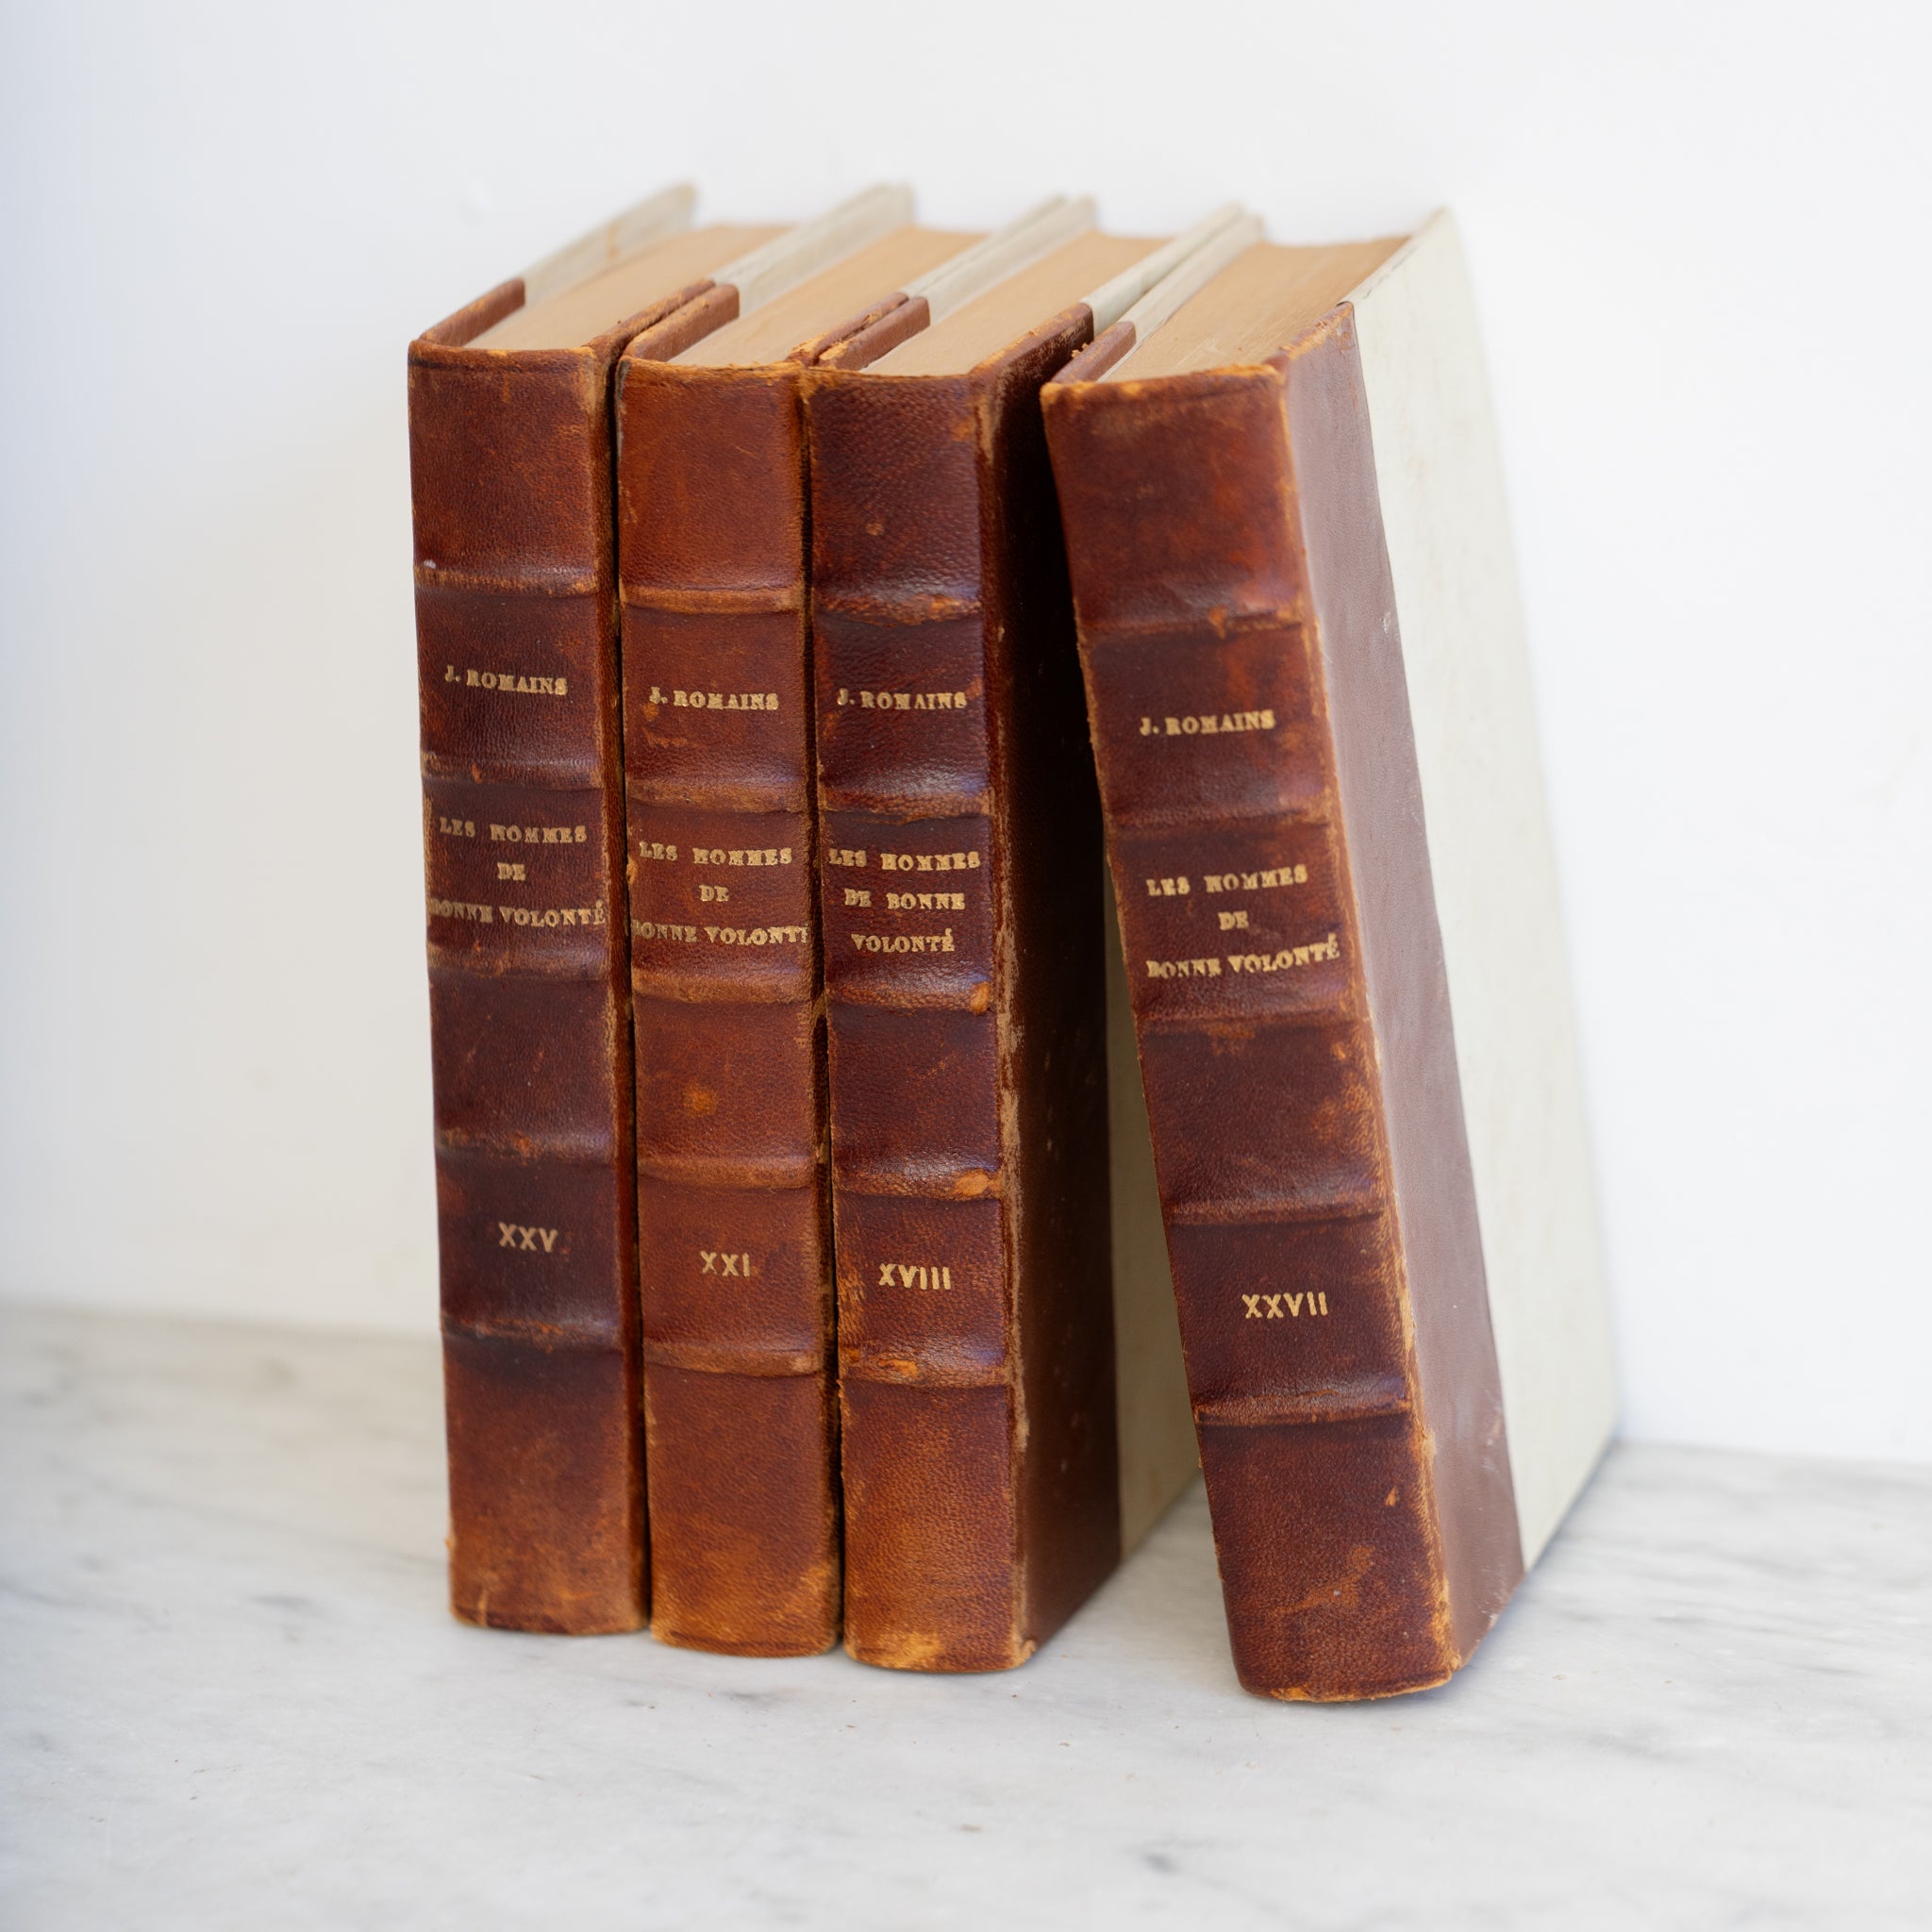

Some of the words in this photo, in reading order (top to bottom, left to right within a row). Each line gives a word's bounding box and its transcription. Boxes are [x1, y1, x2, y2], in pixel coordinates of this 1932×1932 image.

[444, 665, 461, 682] J.
[466, 669, 569, 696] ROMAINS
[649, 687, 668, 704] J.
[673, 690, 779, 710] ROMAINS
[837, 689, 856, 706] J.
[860, 691, 968, 709] ROMAINS
[1140, 717, 1159, 736] J.
[1164, 709, 1275, 736] ROMAINS
[440, 817, 476, 838] LES
[490, 824, 588, 843] HOMMES
[639, 841, 678, 861] LES
[692, 847, 792, 866] HOMMES
[828, 849, 867, 867] LES
[880, 851, 981, 871] HOMMES
[497, 862, 526, 881] DE
[1146, 876, 1191, 896] LES
[1204, 864, 1308, 892] HOMMES
[699, 885, 729, 902] DE
[844, 889, 872, 908] DE
[886, 891, 966, 910] BONNE
[499, 899, 607, 927] VOLONTÉ
[1218, 910, 1249, 930] DE
[851, 928, 956, 954] VOLONTÉ
[1146, 958, 1222, 979] BONNE
[1227, 932, 1341, 974] VOLONTÉ
[498, 1222, 558, 1253] XXV
[700, 1249, 751, 1277] XXI
[878, 1262, 952, 1290] XVIII
[1241, 1291, 1328, 1319] XXVII
